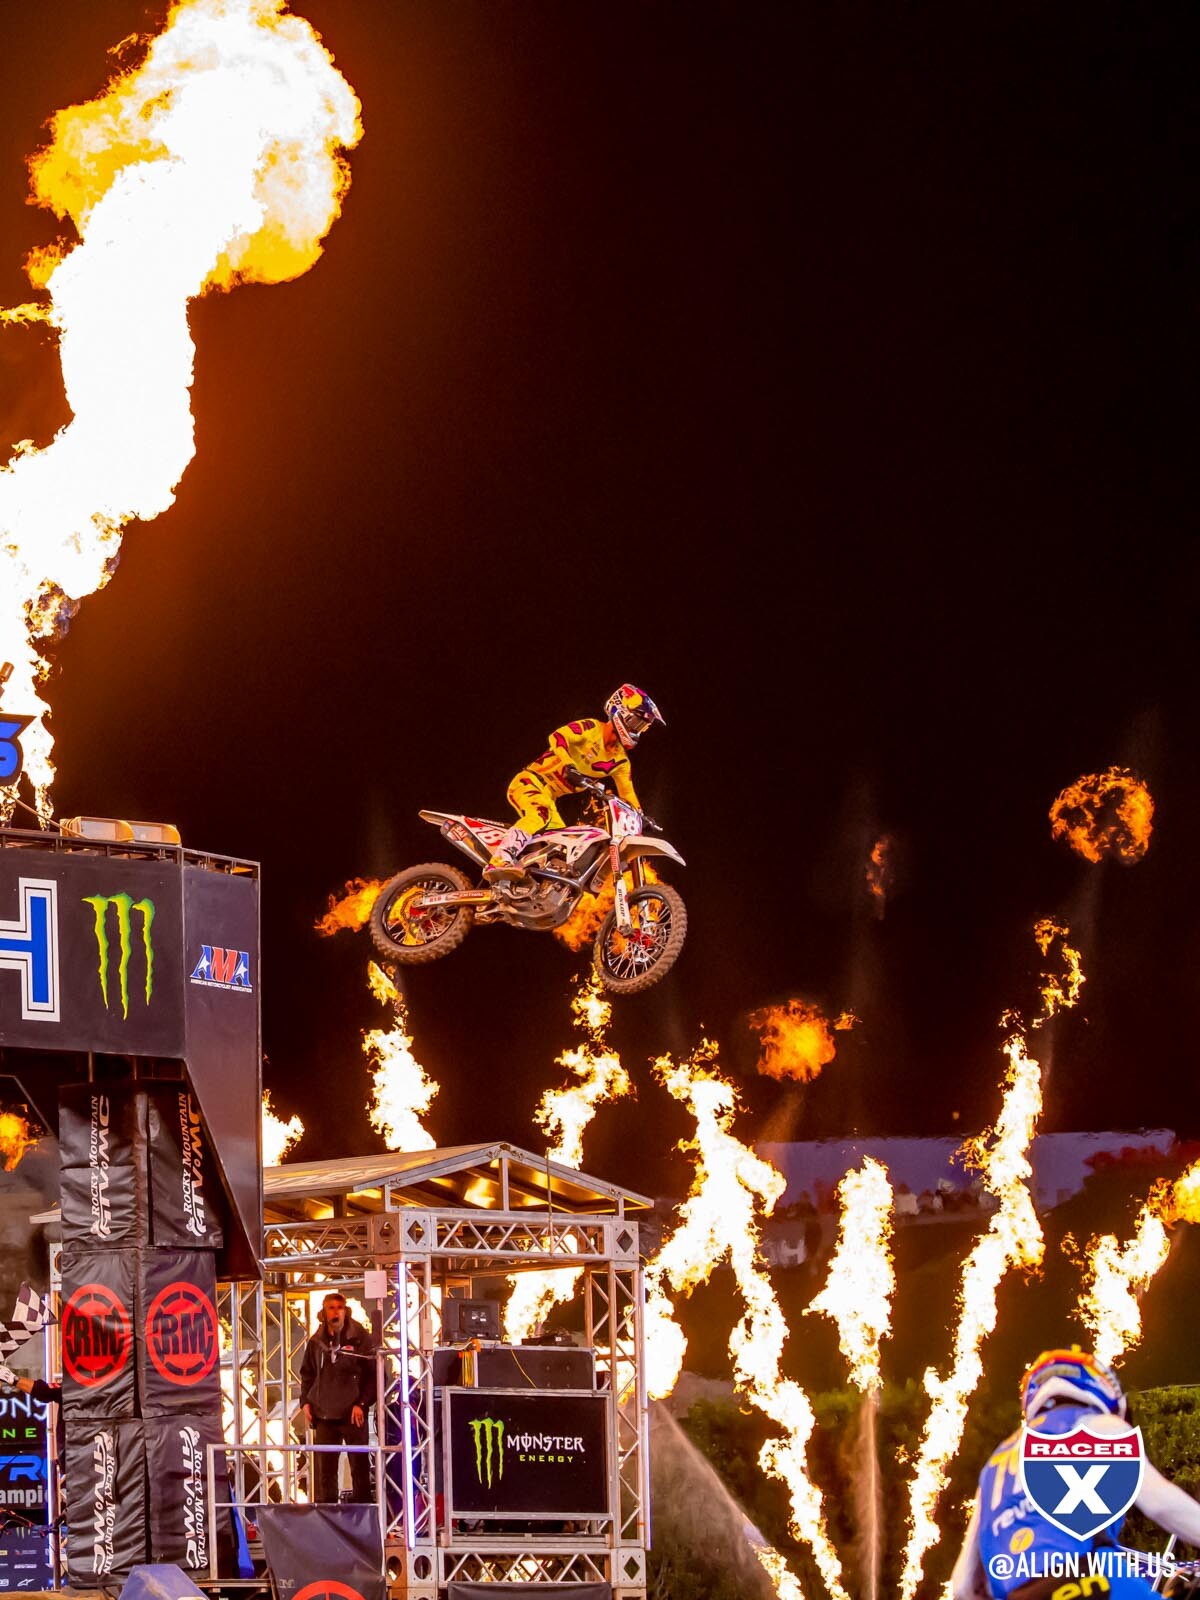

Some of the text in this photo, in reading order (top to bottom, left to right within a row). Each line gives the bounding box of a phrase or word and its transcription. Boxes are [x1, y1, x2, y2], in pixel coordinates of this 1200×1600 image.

[189, 944, 253, 987] AMA
[182, 1168, 192, 1214] ROCKY
[519, 1454, 574, 1463] ENERGY
[103, 1453, 116, 1575] ROCKY MOUNTAIN
[193, 1448, 209, 1569] ROCKY MOUNTAIN
